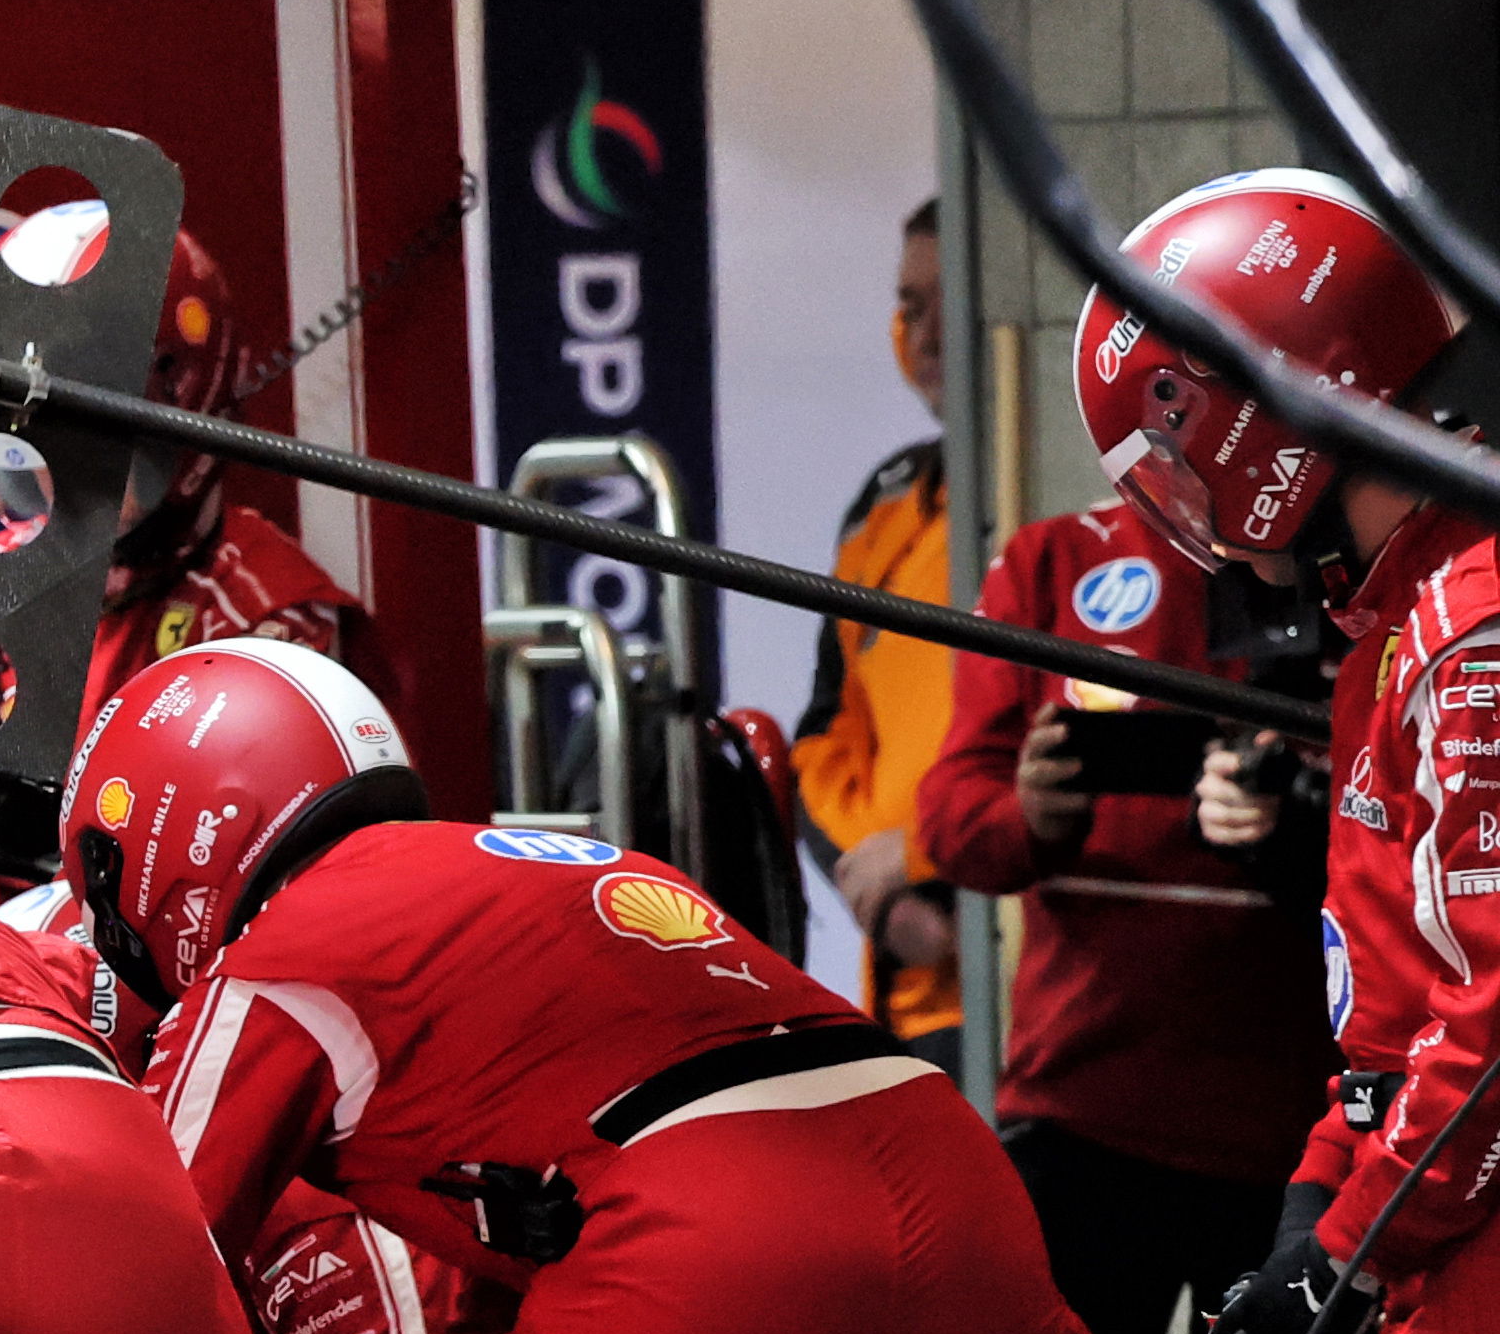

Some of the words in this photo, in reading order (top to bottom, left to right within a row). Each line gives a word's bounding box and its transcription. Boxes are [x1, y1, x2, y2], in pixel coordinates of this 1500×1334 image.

[1236, 220, 1287, 276] PERONI
[558, 252, 643, 419] DP
[1214, 399, 1257, 466] RICHARD
[138, 674, 190, 730] PERONI
[355, 723, 389, 737] BELL
[138, 839, 161, 918] RICHARD
[151, 781, 178, 838] MILLE
[491, 829, 596, 864] hp
[177, 886, 210, 987] CEVA
[266, 1251, 348, 1323] CEVA
